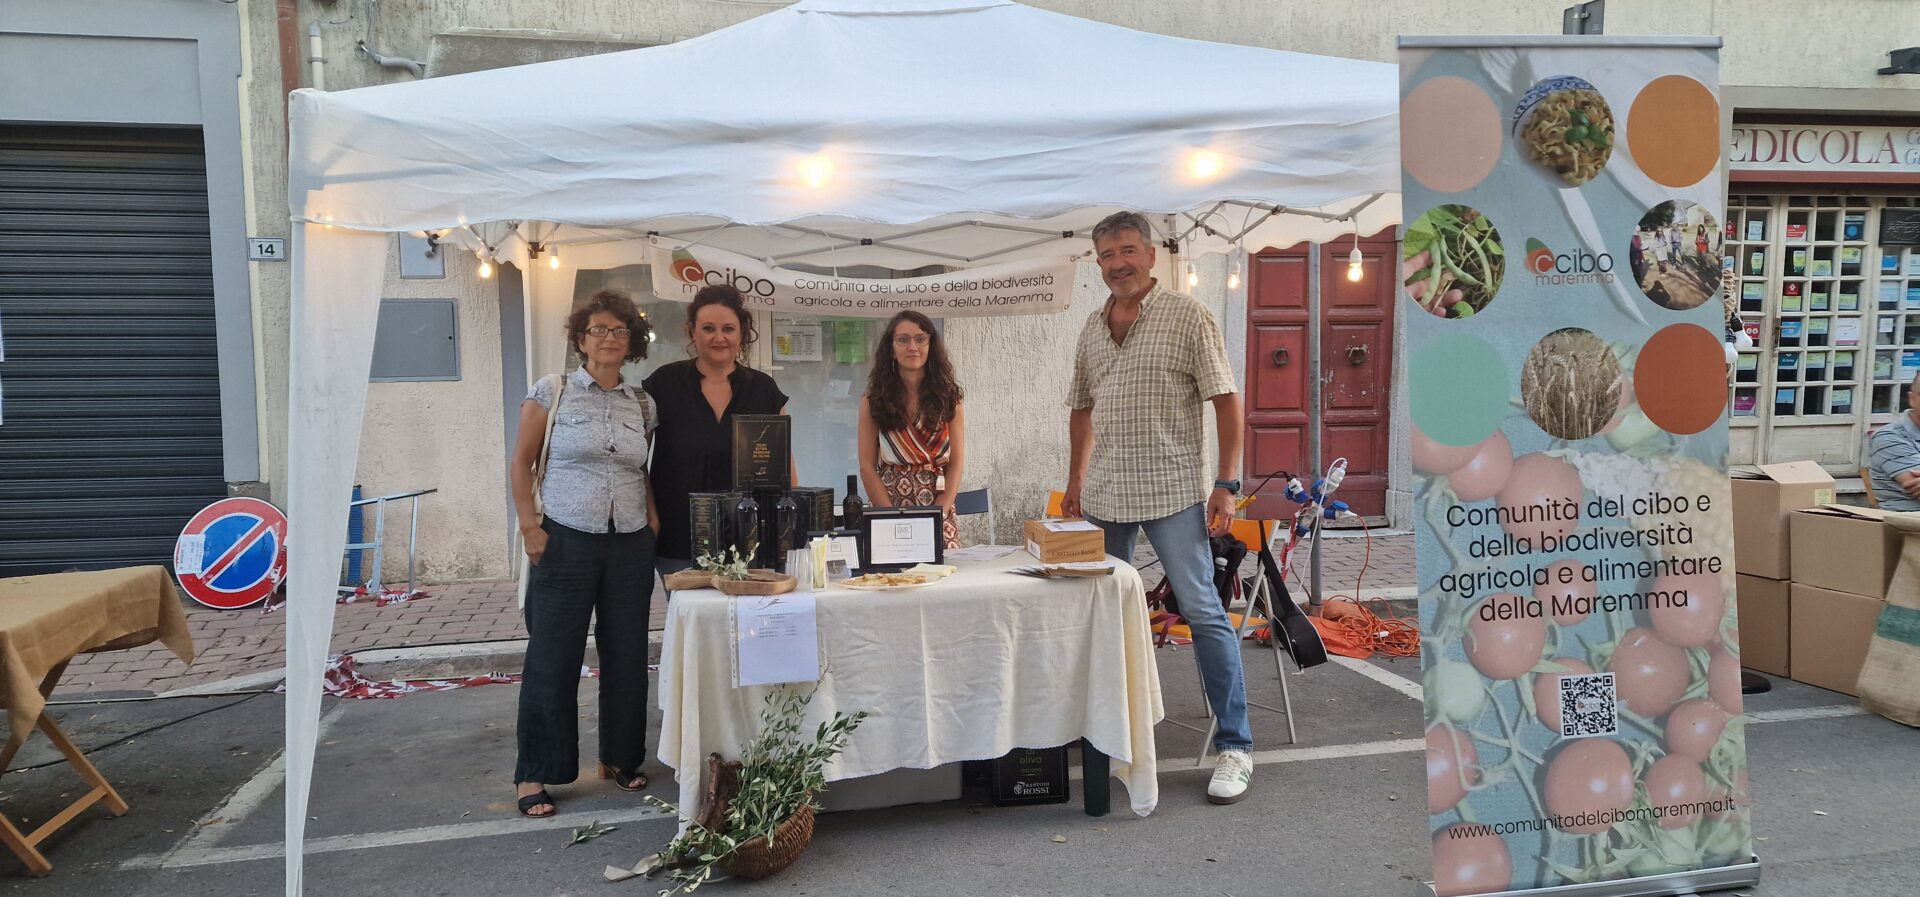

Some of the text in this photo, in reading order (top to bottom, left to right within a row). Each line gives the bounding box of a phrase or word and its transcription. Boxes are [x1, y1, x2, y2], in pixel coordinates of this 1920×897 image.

[257, 243, 275, 255] 14
[869, 283, 892, 294] del
[931, 282, 940, 292] e
[944, 280, 978, 292] della
[981, 272, 1054, 290] biodiversità
[1535, 273, 1615, 286] maremma
[794, 292, 1054, 308] agricola e alimentare della Maremma
[1446, 492, 1711, 527] Comunità del cibo e
[1469, 521, 1693, 558] della biodiversità
[1439, 555, 1722, 598] agricola e alimentare
[1479, 589, 1689, 622] della Maremma
[1023, 787, 1050, 795] ROSSI
[1448, 796, 1735, 840] www.comunitadelcibomaremma.it
